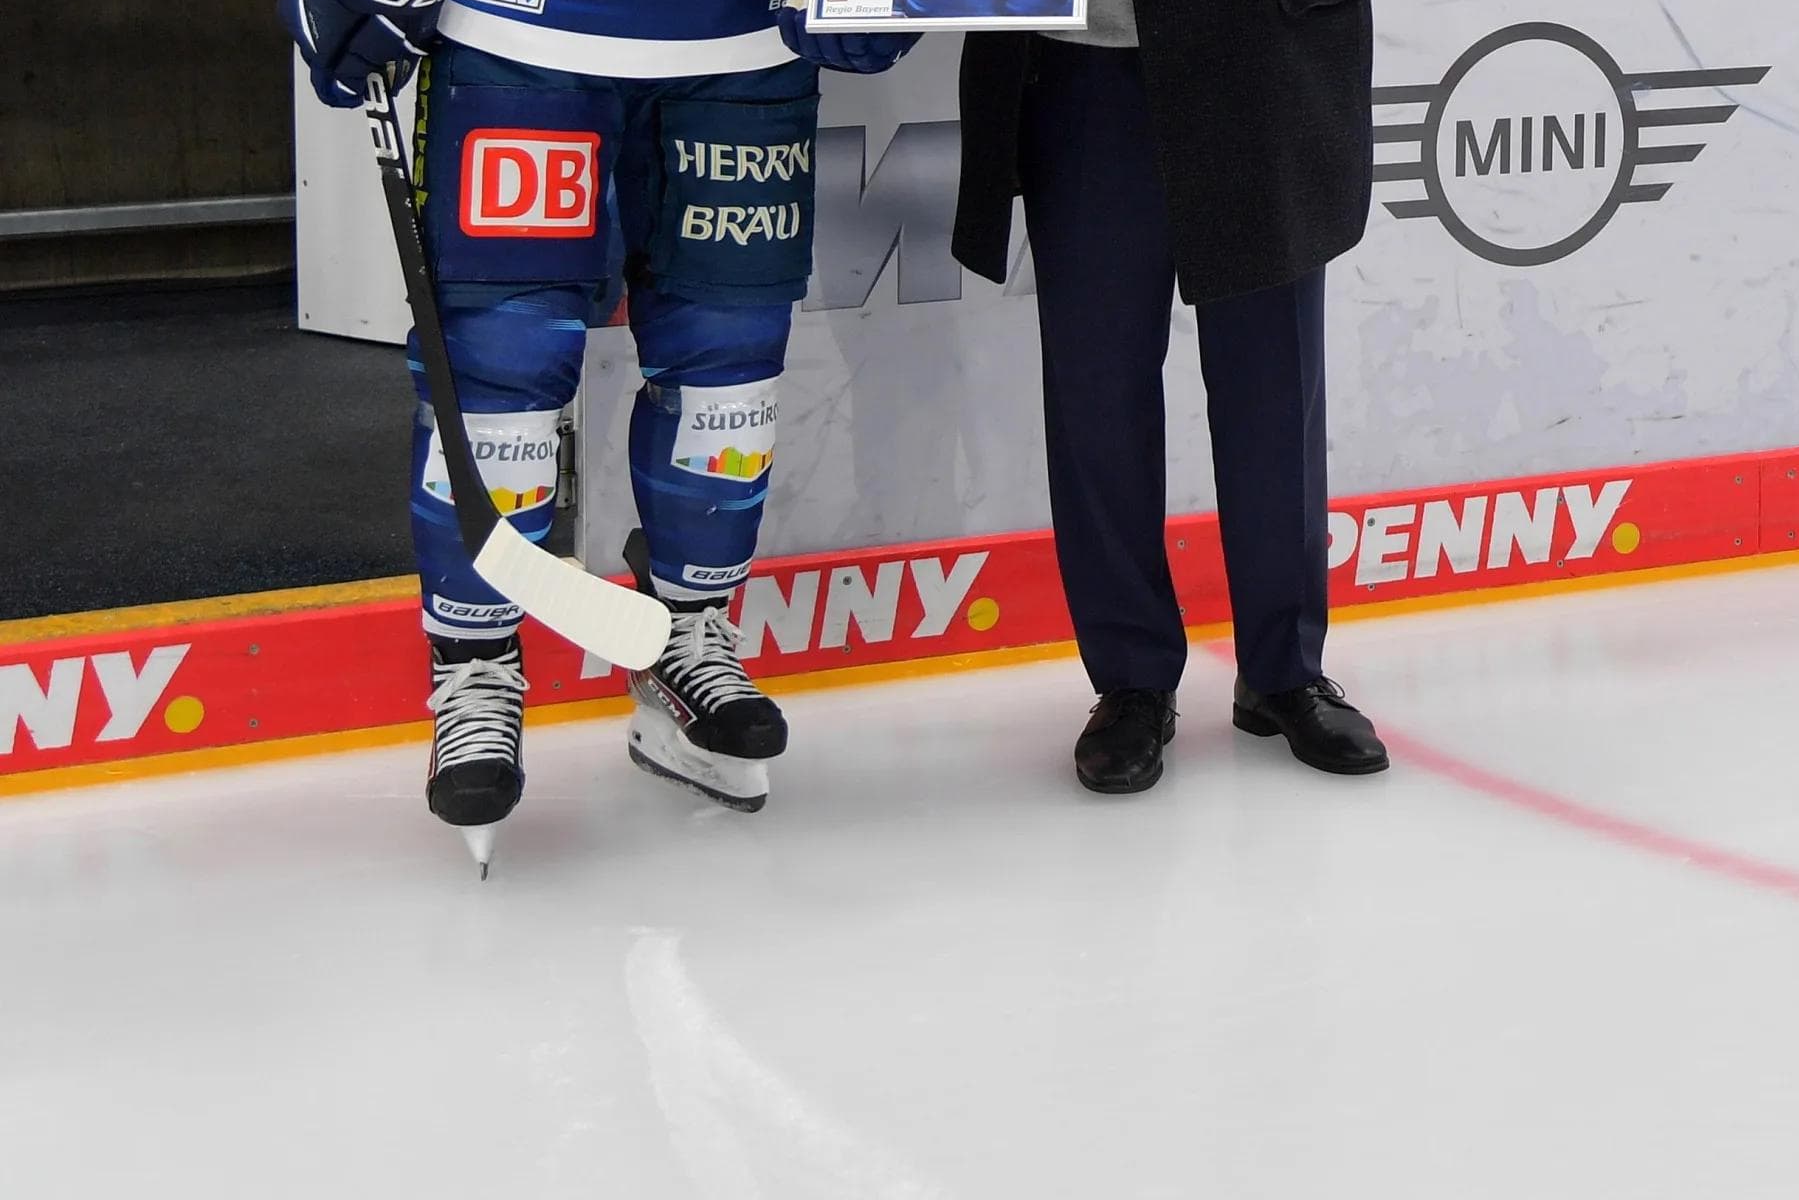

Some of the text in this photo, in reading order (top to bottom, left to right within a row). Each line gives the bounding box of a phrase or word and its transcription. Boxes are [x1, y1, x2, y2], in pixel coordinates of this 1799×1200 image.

[826, 5, 889, 14] Regio Bayern
[1454, 111, 1607, 179] MINI
[481, 146, 586, 220] DB
[682, 202, 800, 246] BRÄU
